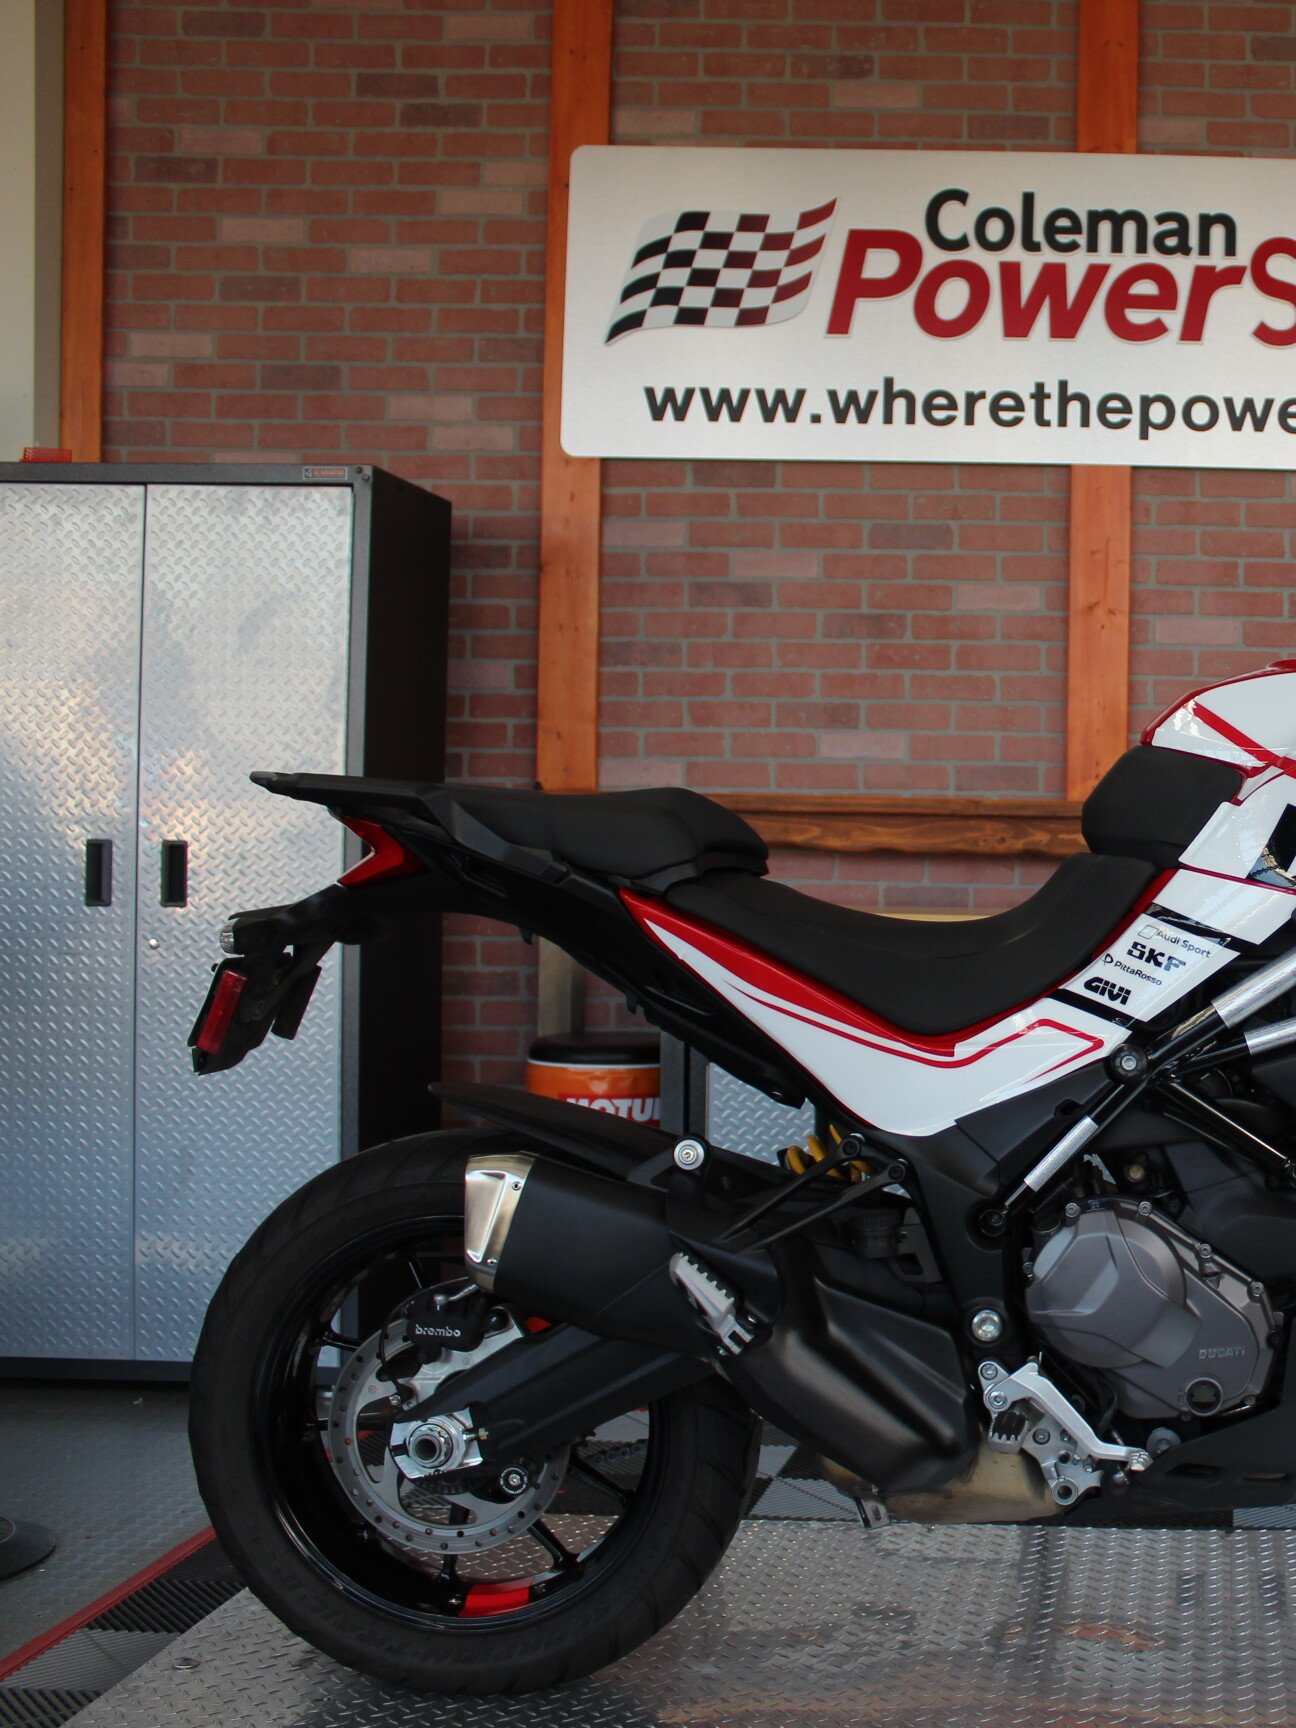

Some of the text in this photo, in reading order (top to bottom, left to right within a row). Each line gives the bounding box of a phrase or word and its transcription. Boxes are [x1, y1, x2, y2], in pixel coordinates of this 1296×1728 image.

[924, 187, 1237, 257] Coleman
[1126, 941, 1187, 972] SKF
[1156, 929, 1212, 959] Audi Sport
[1114, 960, 1163, 987] PittaRosso
[1083, 976, 1132, 1006] GIVI
[566, 1096, 661, 1122] OTU
[415, 1324, 462, 1338] brembo
